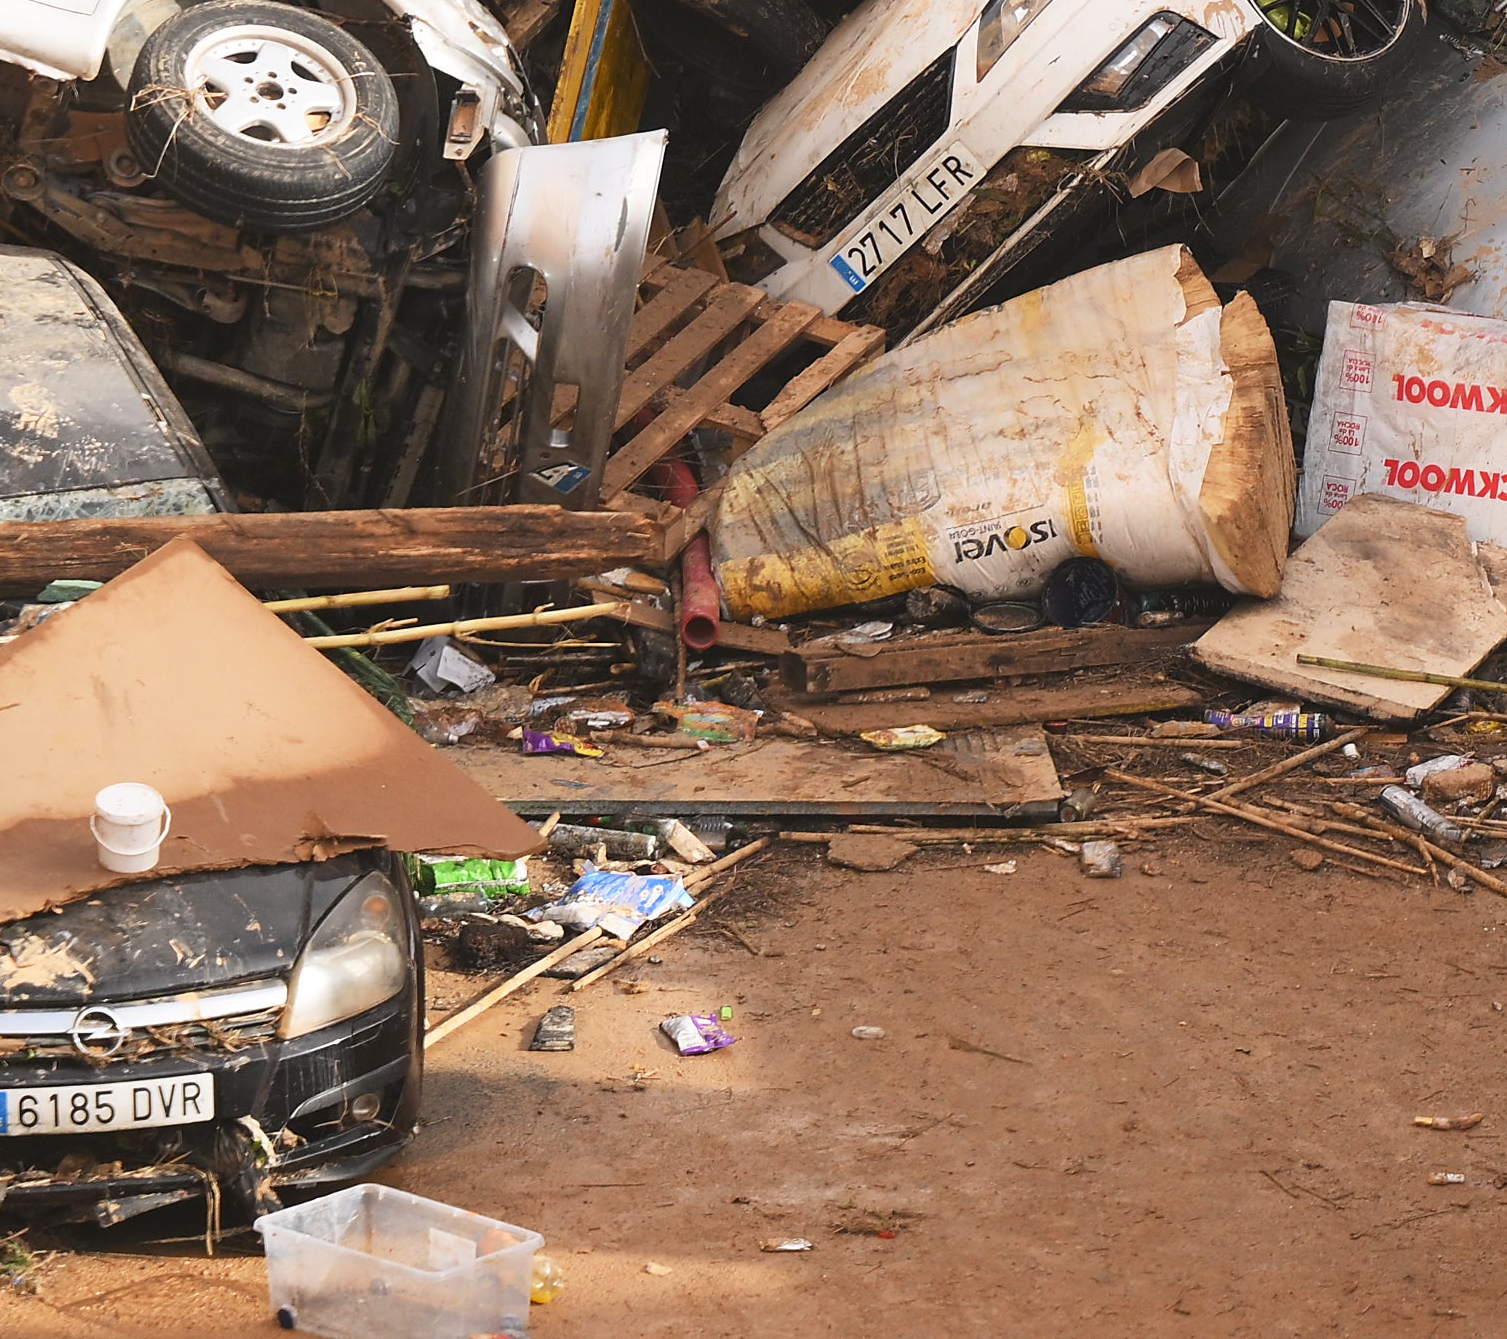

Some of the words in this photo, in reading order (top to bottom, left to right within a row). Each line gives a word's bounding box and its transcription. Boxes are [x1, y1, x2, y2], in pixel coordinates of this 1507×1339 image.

[846, 201, 917, 278] 2717
[909, 154, 976, 218] LFR
[1345, 372, 1371, 385] 100%
[1333, 433, 1360, 447] 100%
[1323, 498, 1346, 510] 00%
[16, 1087, 117, 1131] 6185
[131, 1079, 202, 1123] DVR
